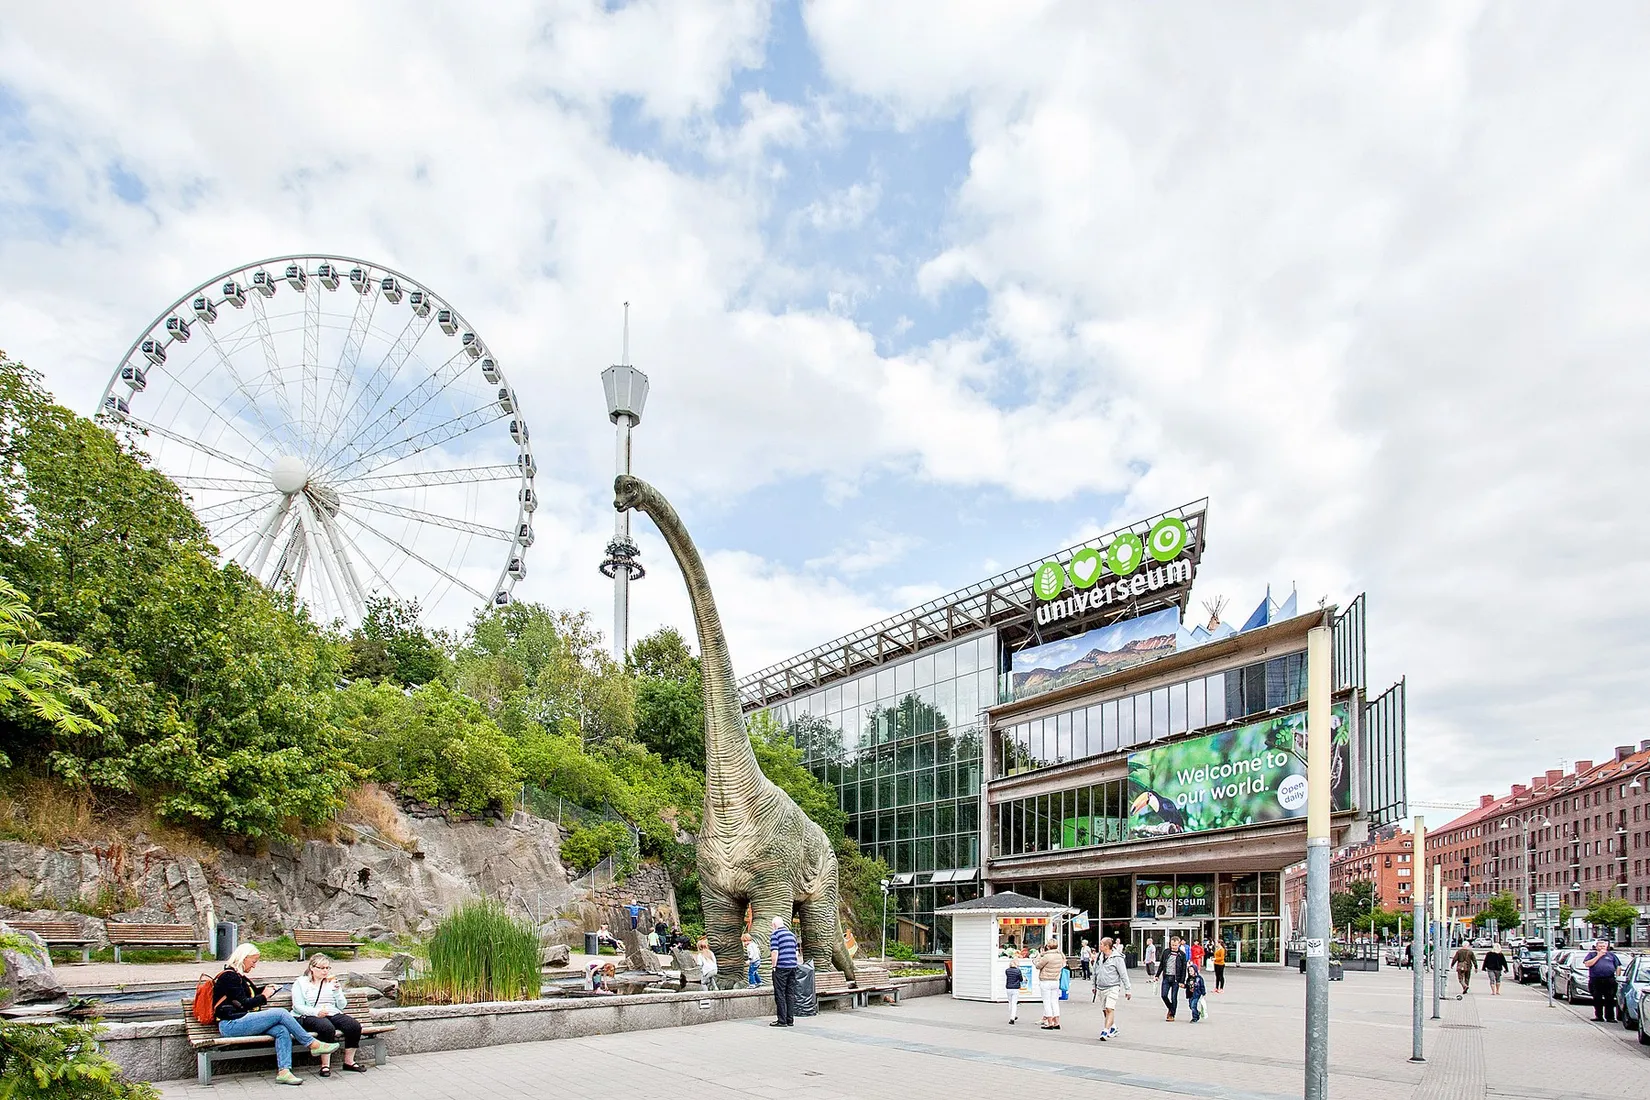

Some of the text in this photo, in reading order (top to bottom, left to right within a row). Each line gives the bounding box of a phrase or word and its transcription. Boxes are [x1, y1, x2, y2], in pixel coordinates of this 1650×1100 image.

[1036, 558, 1192, 626] universeum
[1177, 752, 1288, 786] Welcome to
[1176, 774, 1270, 806] our world.
[1281, 781, 1305, 796] Open
[1284, 791, 1305, 804] daily
